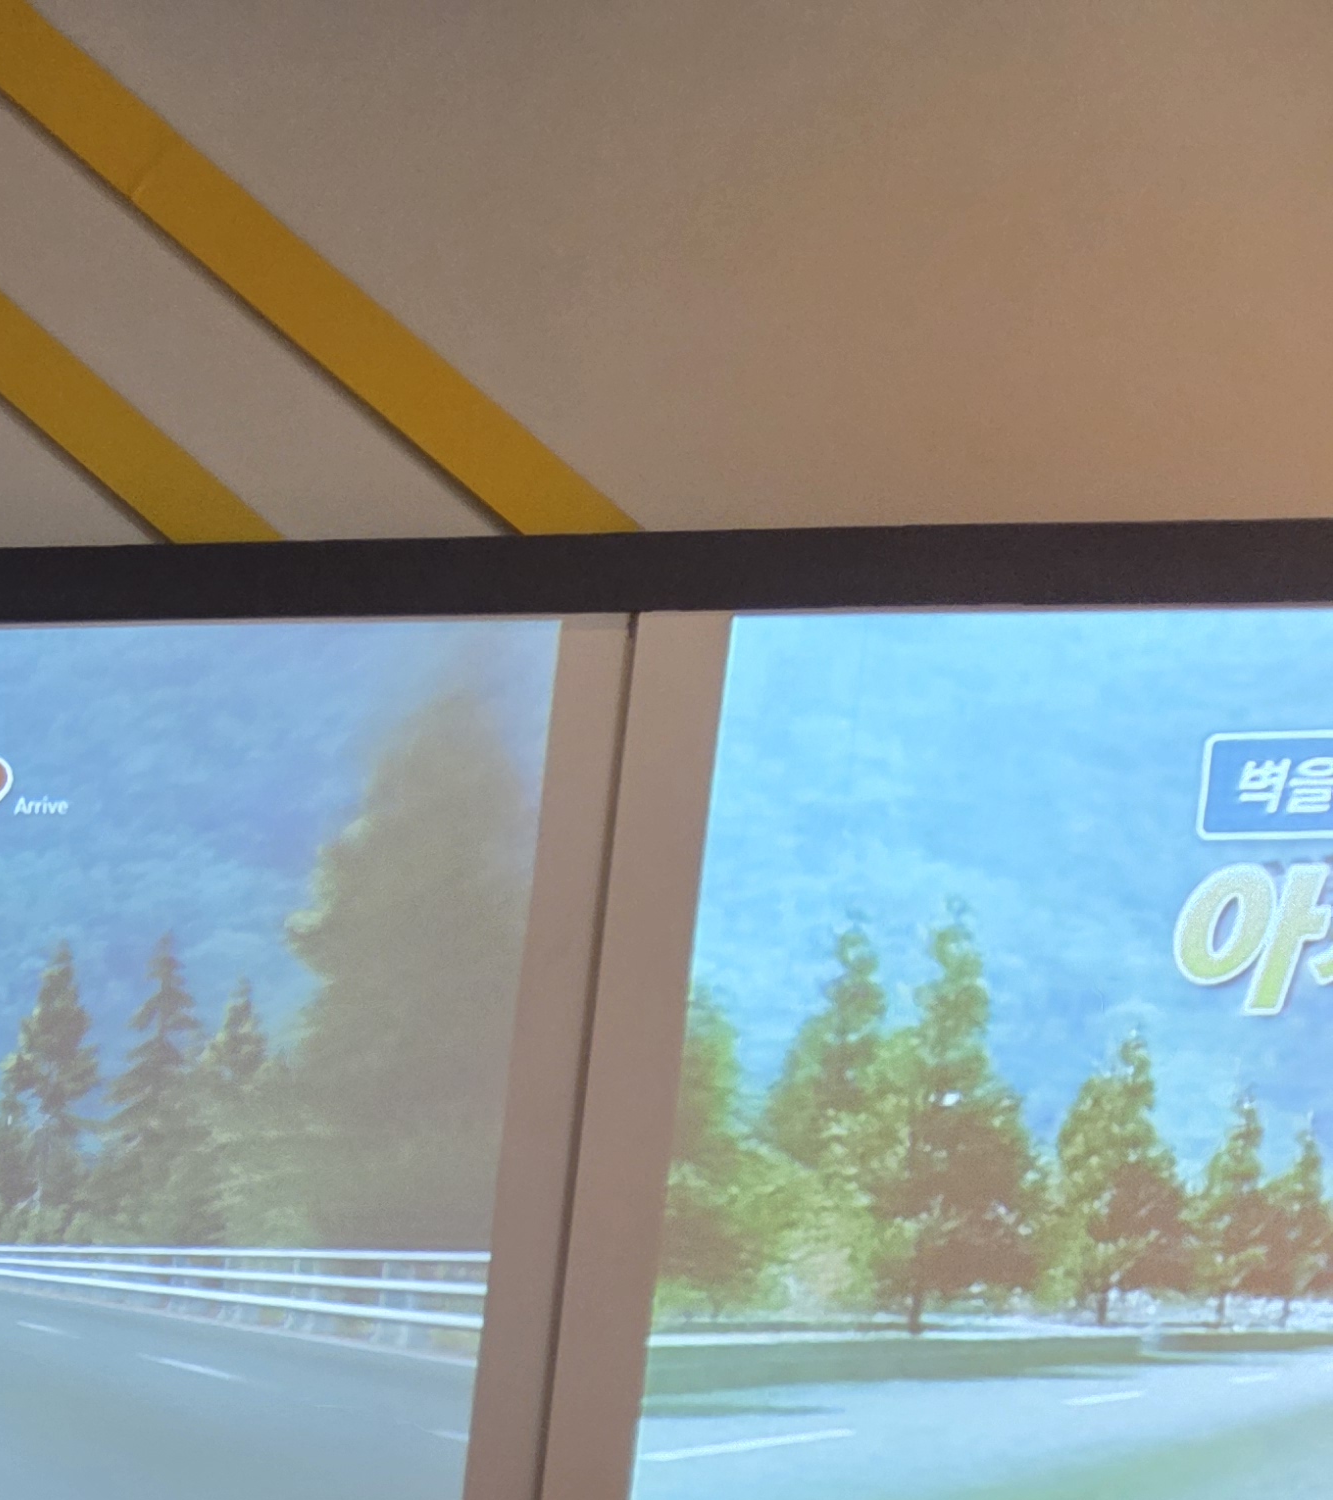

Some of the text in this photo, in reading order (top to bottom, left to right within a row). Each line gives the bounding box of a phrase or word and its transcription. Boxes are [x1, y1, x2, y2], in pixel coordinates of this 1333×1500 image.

[13, 794, 69, 816] Arrive
[1238, 756, 1333, 814] 벽을
[1173, 862, 1333, 1016] 아
